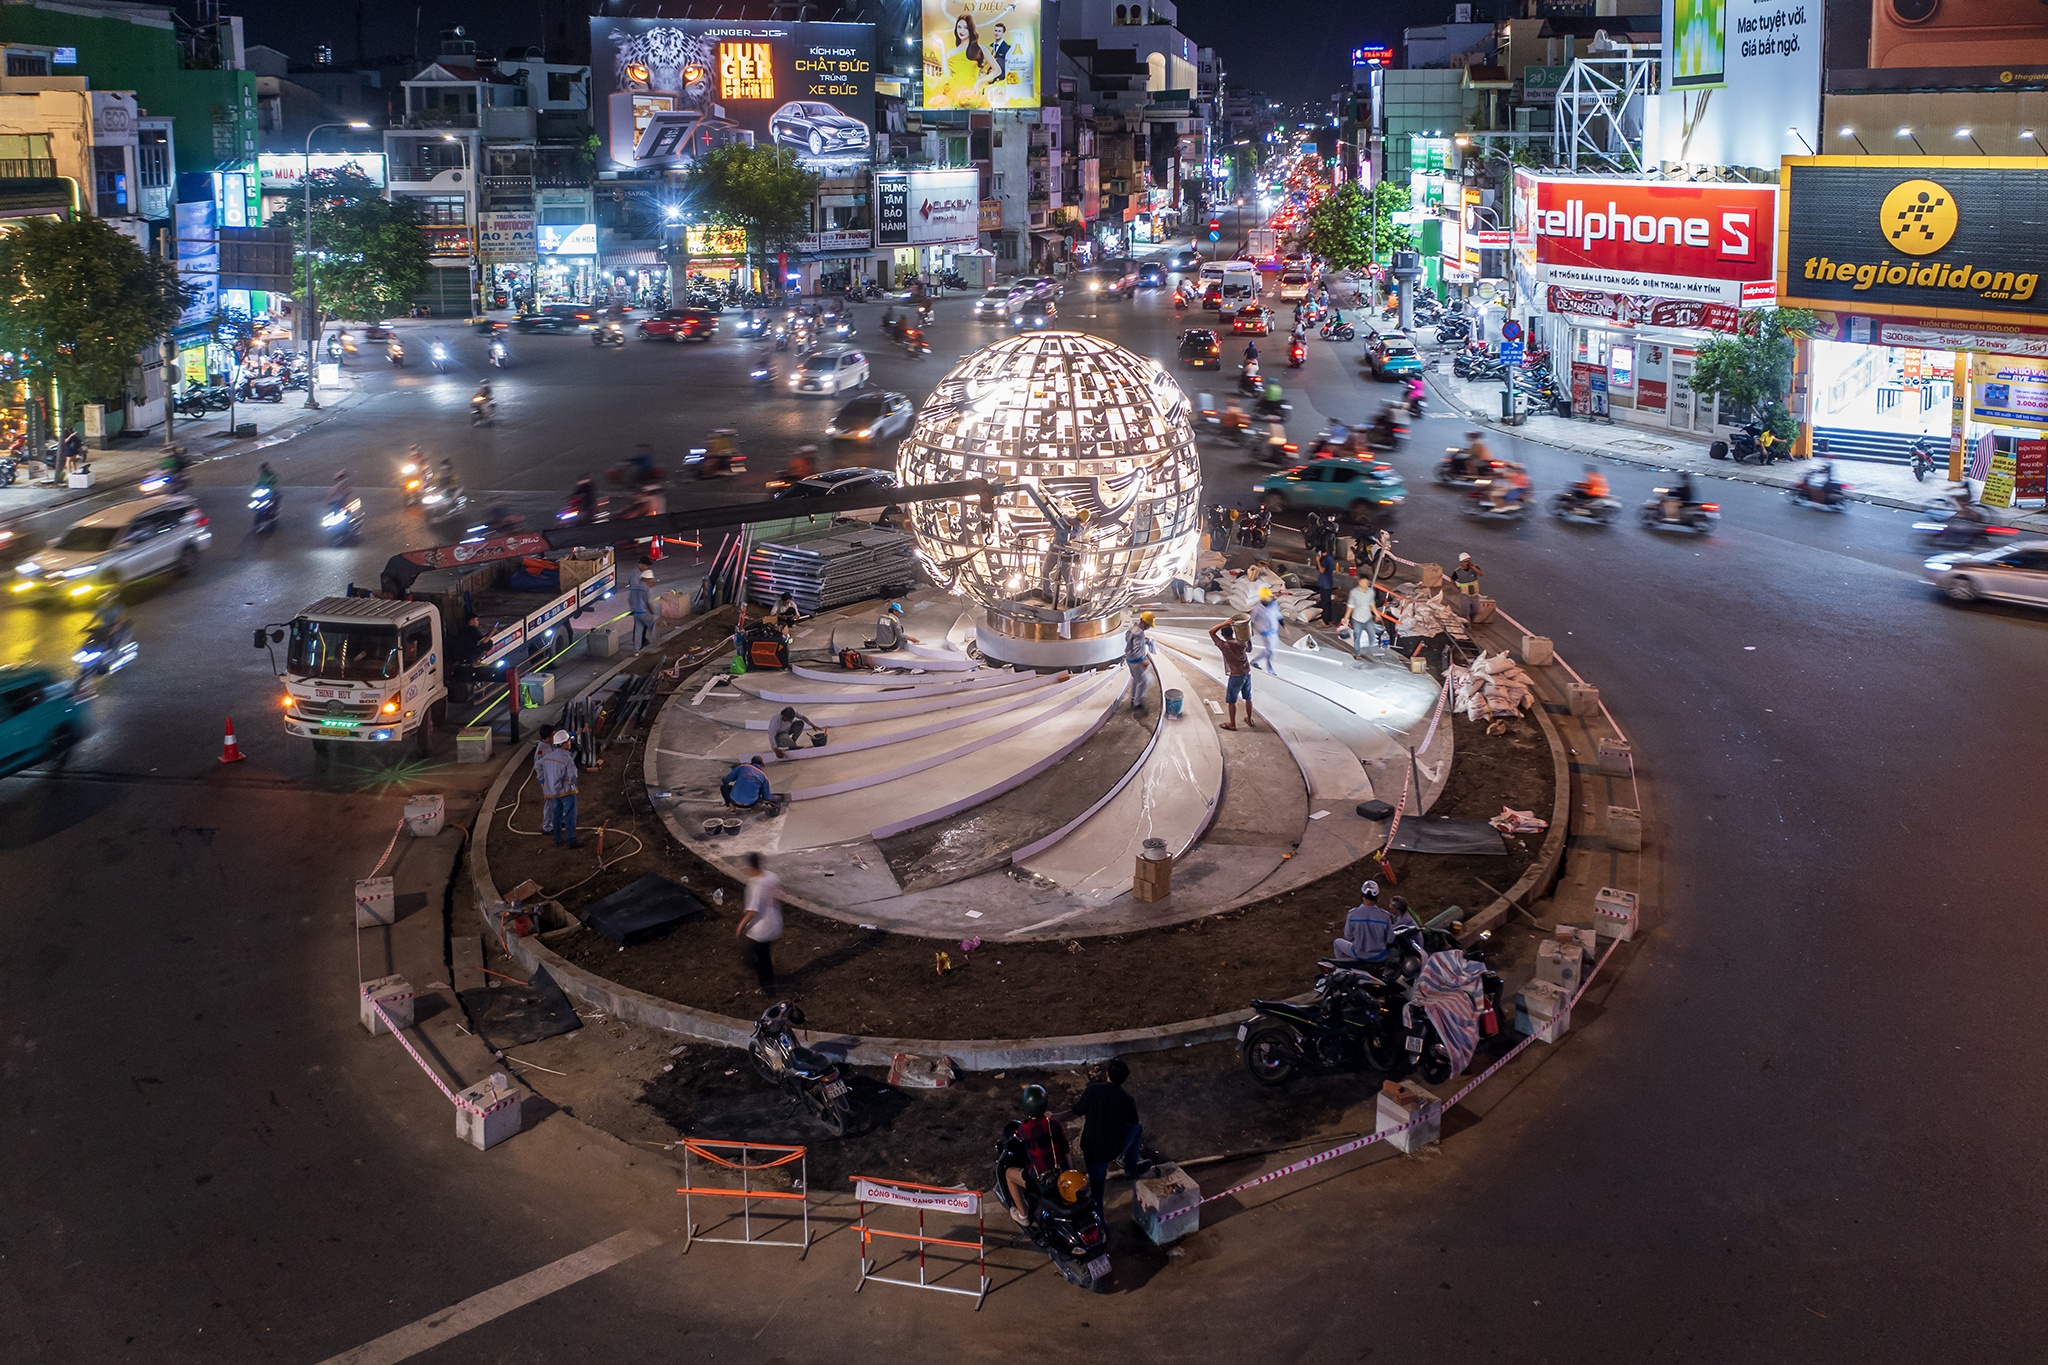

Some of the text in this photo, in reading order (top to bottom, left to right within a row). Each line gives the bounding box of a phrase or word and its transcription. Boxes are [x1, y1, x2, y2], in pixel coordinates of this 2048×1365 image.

[1737, 5, 1807, 34] Mac tuyệt vời.
[704, 29, 751, 37] JUNGER
[1741, 33, 1800, 57] Giá bất ngờ.
[809, 46, 856, 57] KÍCH HOẠT
[795, 56, 870, 72] CHẤT ĐỨC
[819, 73, 848, 81] TRÚNG
[808, 83, 858, 95] XE ĐỨC
[275, 168, 296, 179] MUA
[880, 184, 907, 193] TRUNG
[884, 195, 903, 204] TÂM
[884, 206, 902, 218] BẢO
[480, 221, 488, 231] IN
[493, 220, 535, 231] PHOTOCOPY
[881, 220, 906, 231] HÀNH
[1537, 200, 1709, 251] cellphone
[1550, 270, 1557, 278] HỆ
[1558, 270, 1580, 280] THỐNG
[1581, 272, 1593, 280] BÁN
[1603, 275, 1620, 284] TOÀN
[1621, 276, 1640, 286] QUỐC
[1643, 279, 1659, 288] ĐIỆN
[1660, 281, 1682, 291] THOẠI
[1687, 282, 1703, 292] MÁY
[1704, 285, 1721, 293] TÍNH
[1804, 257, 2038, 300] thegioididong
[1980, 291, 2009, 299] .com
[1919, 320, 1940, 328] LUÔN
[1986, 325, 2020, 333] 500.000
[1886, 332, 1902, 341] 300
[1946, 338, 1962, 346] triệu
[1975, 339, 1986, 347] 12
[1986, 341, 2007, 350] tháng
[338, 690, 352, 699] HUY
[868, 1188, 890, 1198] CÔNG
[947, 1198, 969, 1209] CÔNG
